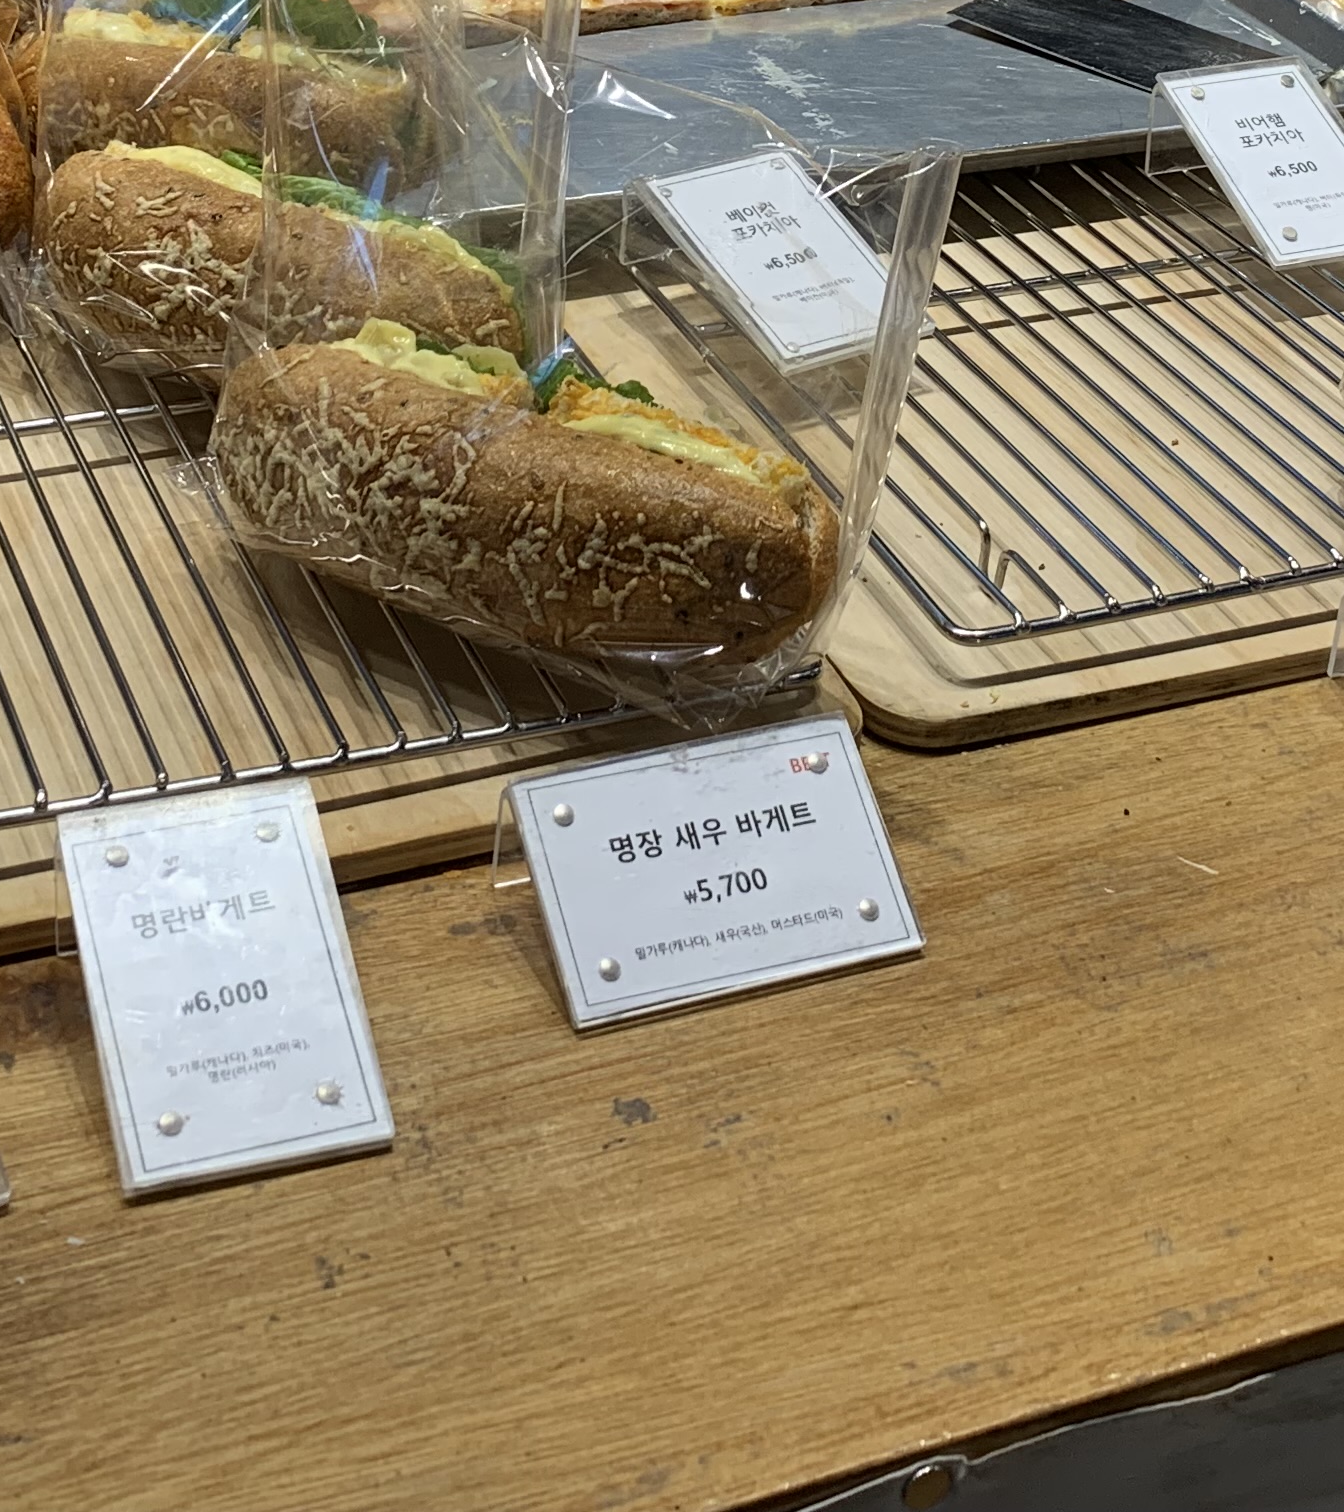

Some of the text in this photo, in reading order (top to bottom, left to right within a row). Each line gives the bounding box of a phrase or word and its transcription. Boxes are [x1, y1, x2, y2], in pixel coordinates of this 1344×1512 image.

[1234, 112, 1286, 132] 비어햄
[1239, 128, 1305, 149] 포카치아
[1267, 160, 1318, 179] ₩6,500
[726, 201, 780, 222] 베이컨
[731, 215, 801, 242] 포카치아
[763, 247, 818, 271] ₩6,500
[609, 801, 817, 864] 명장 새우 바게트
[683, 867, 769, 905] ₩5,700
[131, 890, 276, 939] 명란바게트
[181, 979, 269, 1017] ₩6,000
